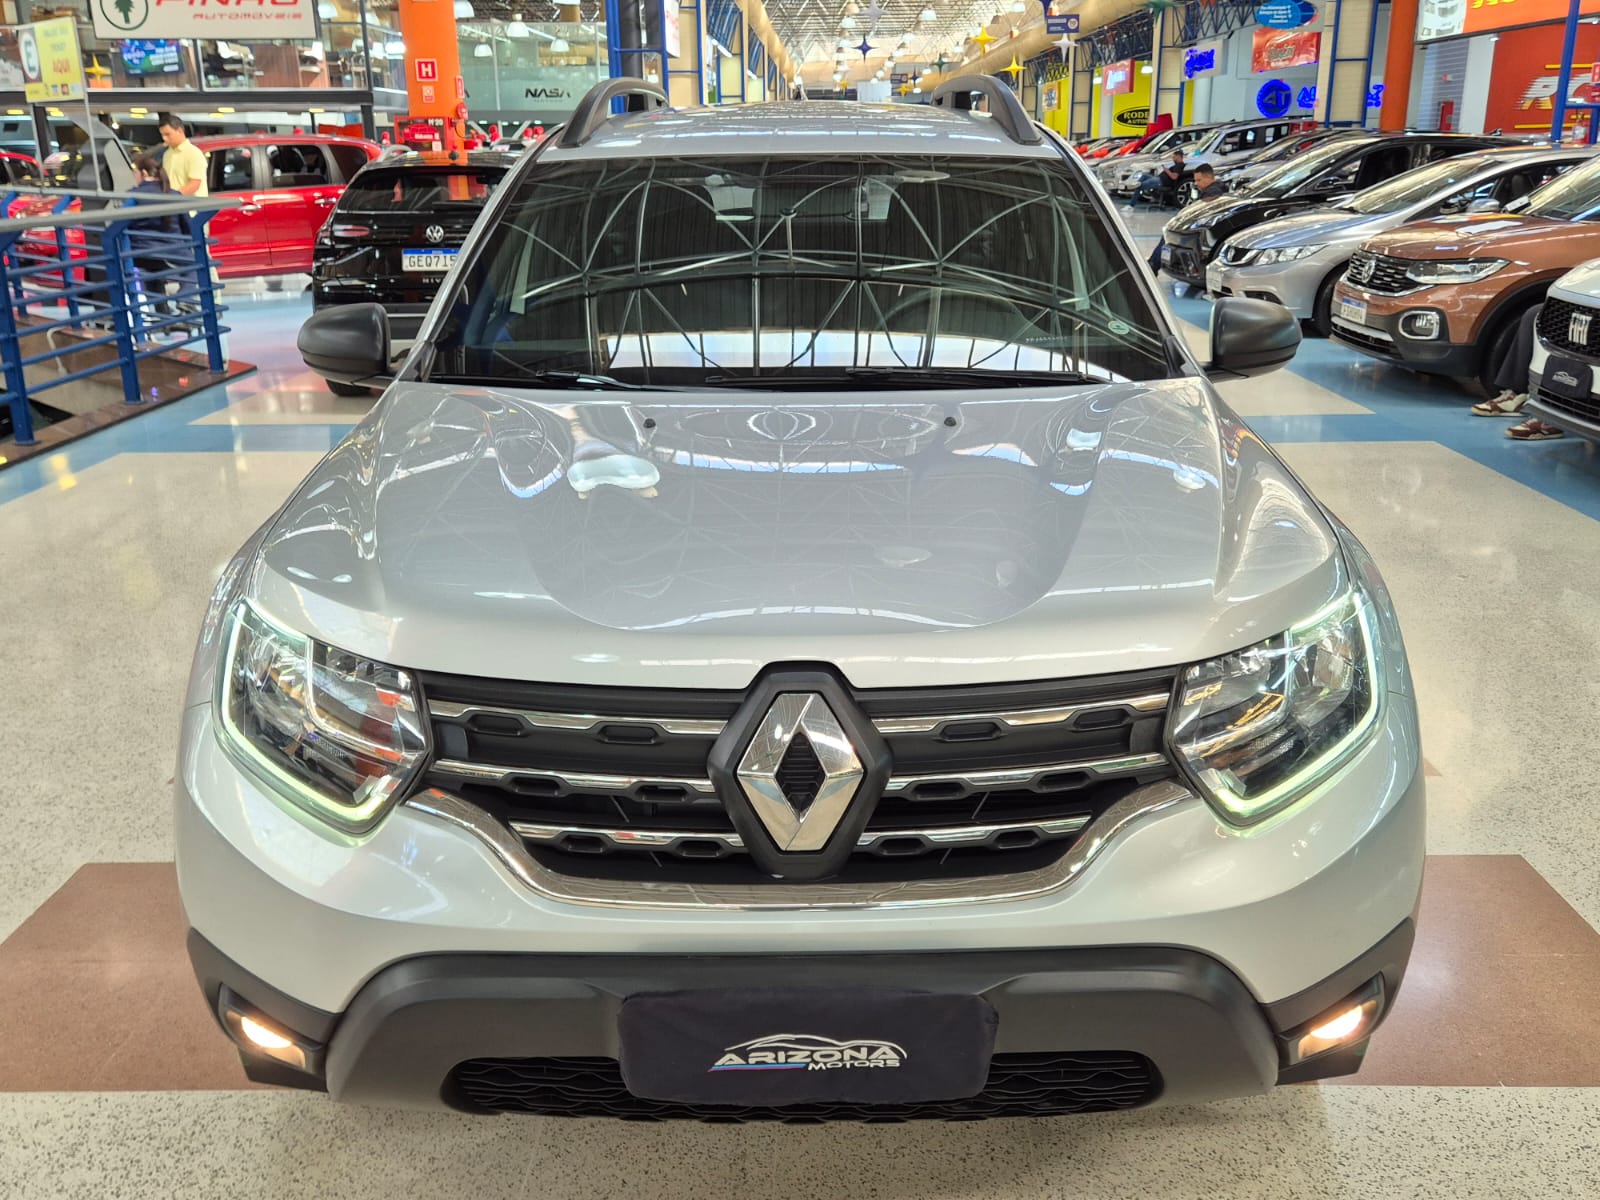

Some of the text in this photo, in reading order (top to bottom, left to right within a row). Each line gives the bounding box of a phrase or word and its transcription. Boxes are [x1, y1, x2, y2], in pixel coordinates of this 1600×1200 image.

[421, 63, 432, 77] H
[525, 88, 571, 98] NASA
[714, 1047, 900, 1066] ARIZONA
[808, 1060, 900, 1070] MOTORS
